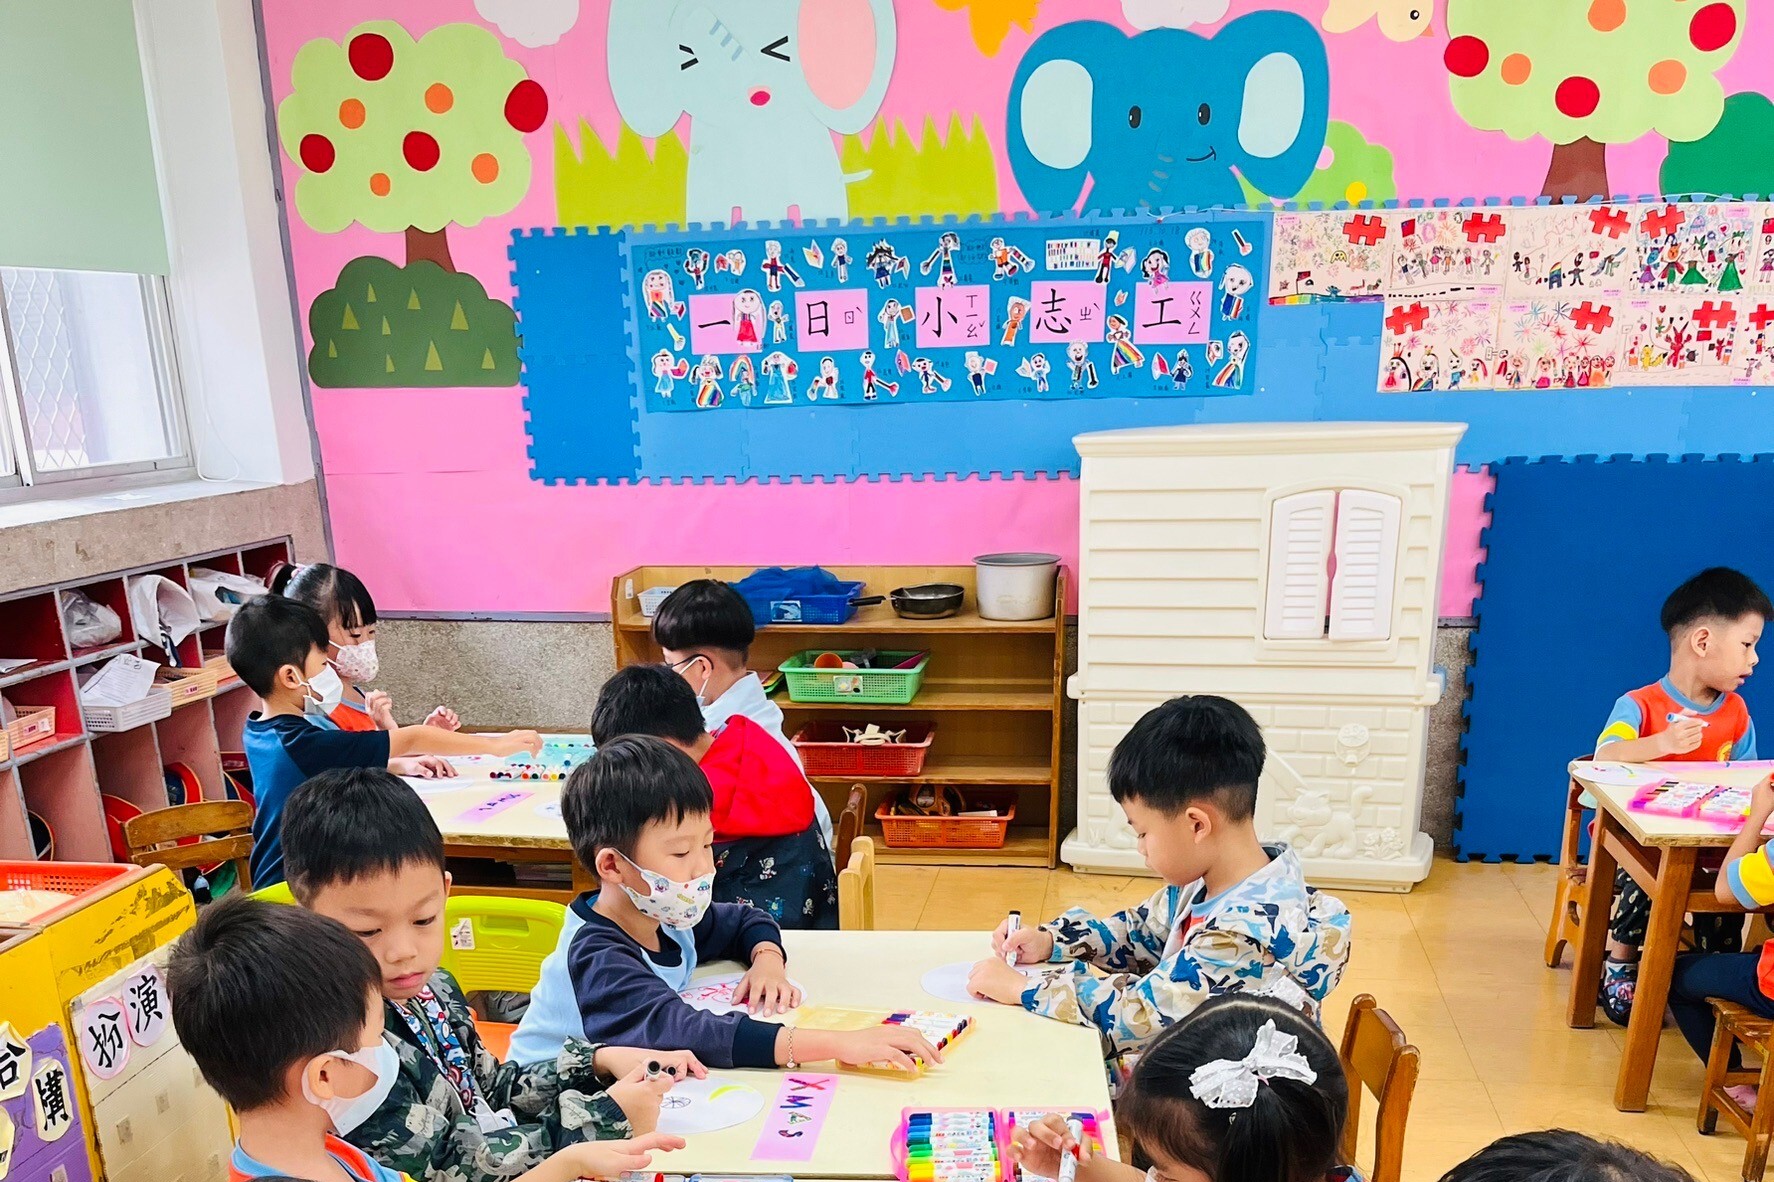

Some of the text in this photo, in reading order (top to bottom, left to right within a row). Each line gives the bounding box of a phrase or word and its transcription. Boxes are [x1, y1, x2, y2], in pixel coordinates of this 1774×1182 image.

[806, 300, 830, 338] 日
[921, 296, 959, 339] 小
[1035, 288, 1073, 335] 志
[1141, 297, 1183, 329] 工
[778, 1078, 830, 1138] XMAS
